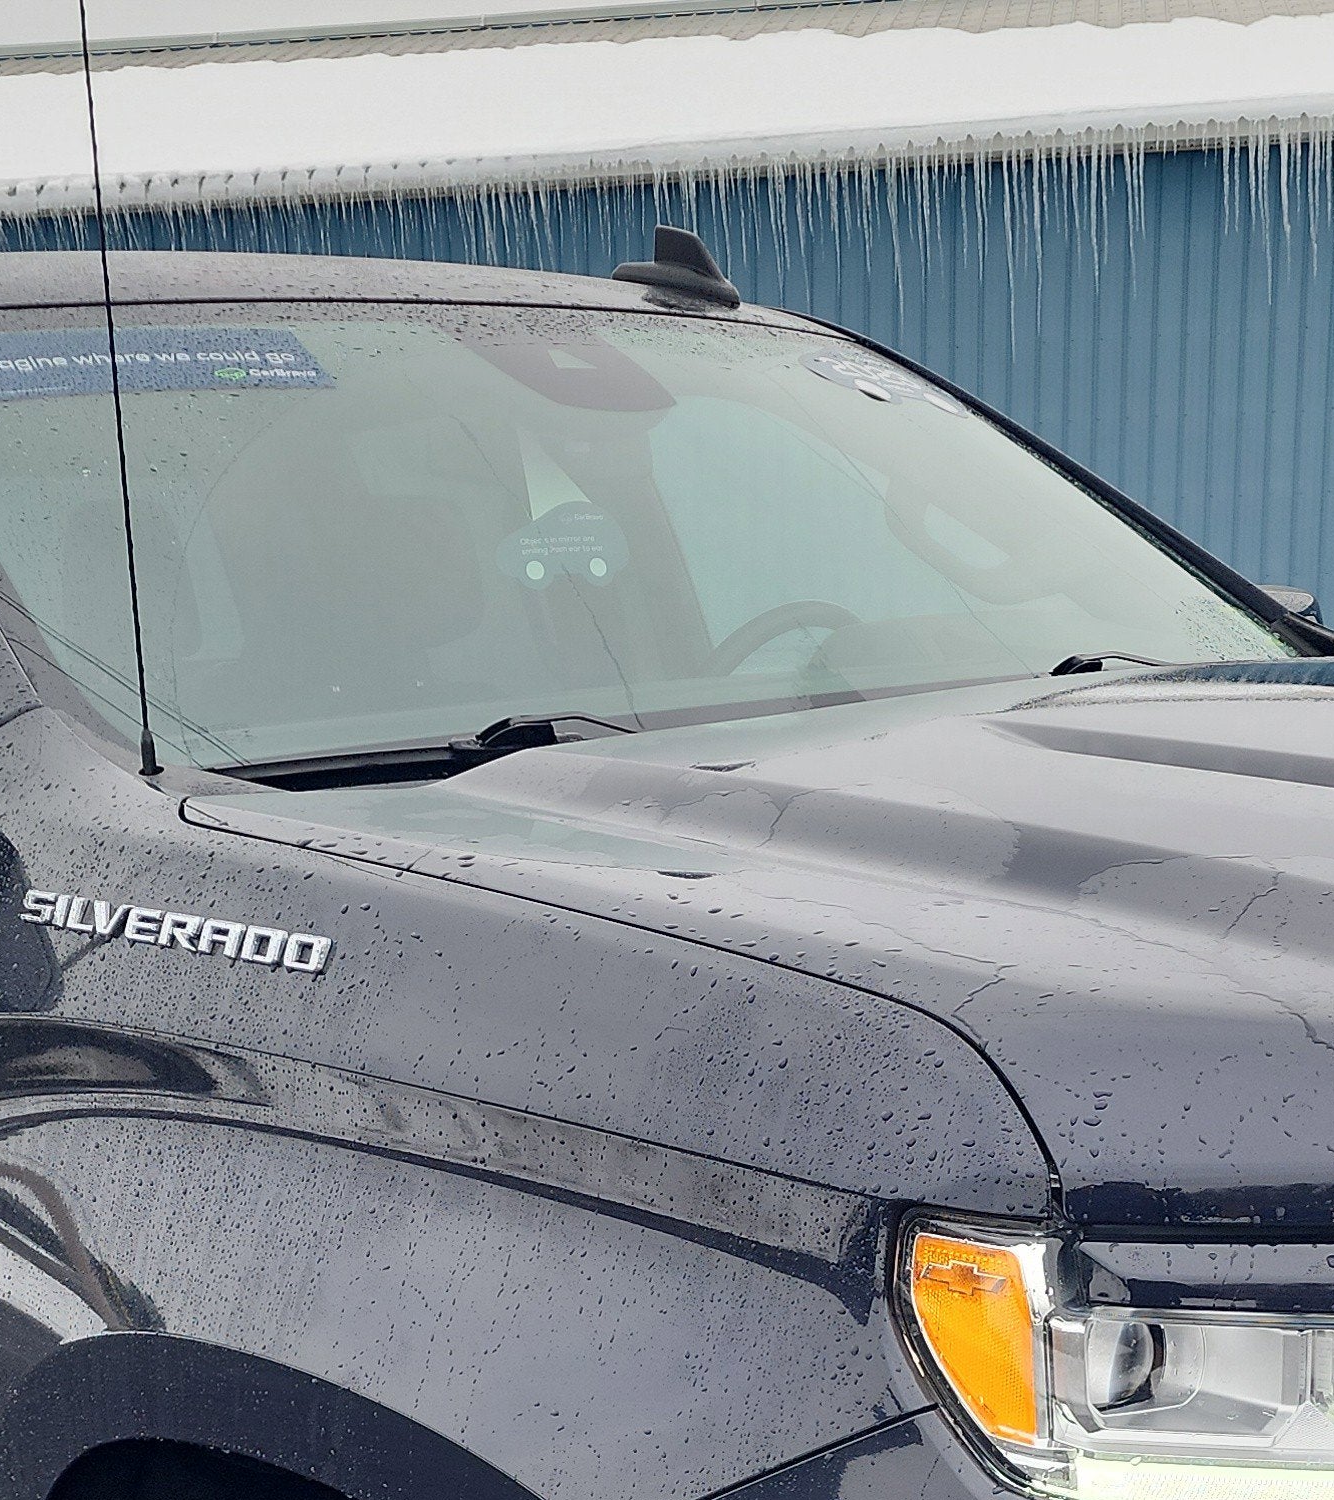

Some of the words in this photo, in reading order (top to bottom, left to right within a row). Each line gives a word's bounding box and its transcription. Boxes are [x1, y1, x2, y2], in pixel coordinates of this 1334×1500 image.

[71, 351, 150, 366] where
[154, 352, 191, 363] we
[196, 350, 261, 363] could
[265, 352, 295, 365] go
[17, 889, 333, 974] SILVERADO
